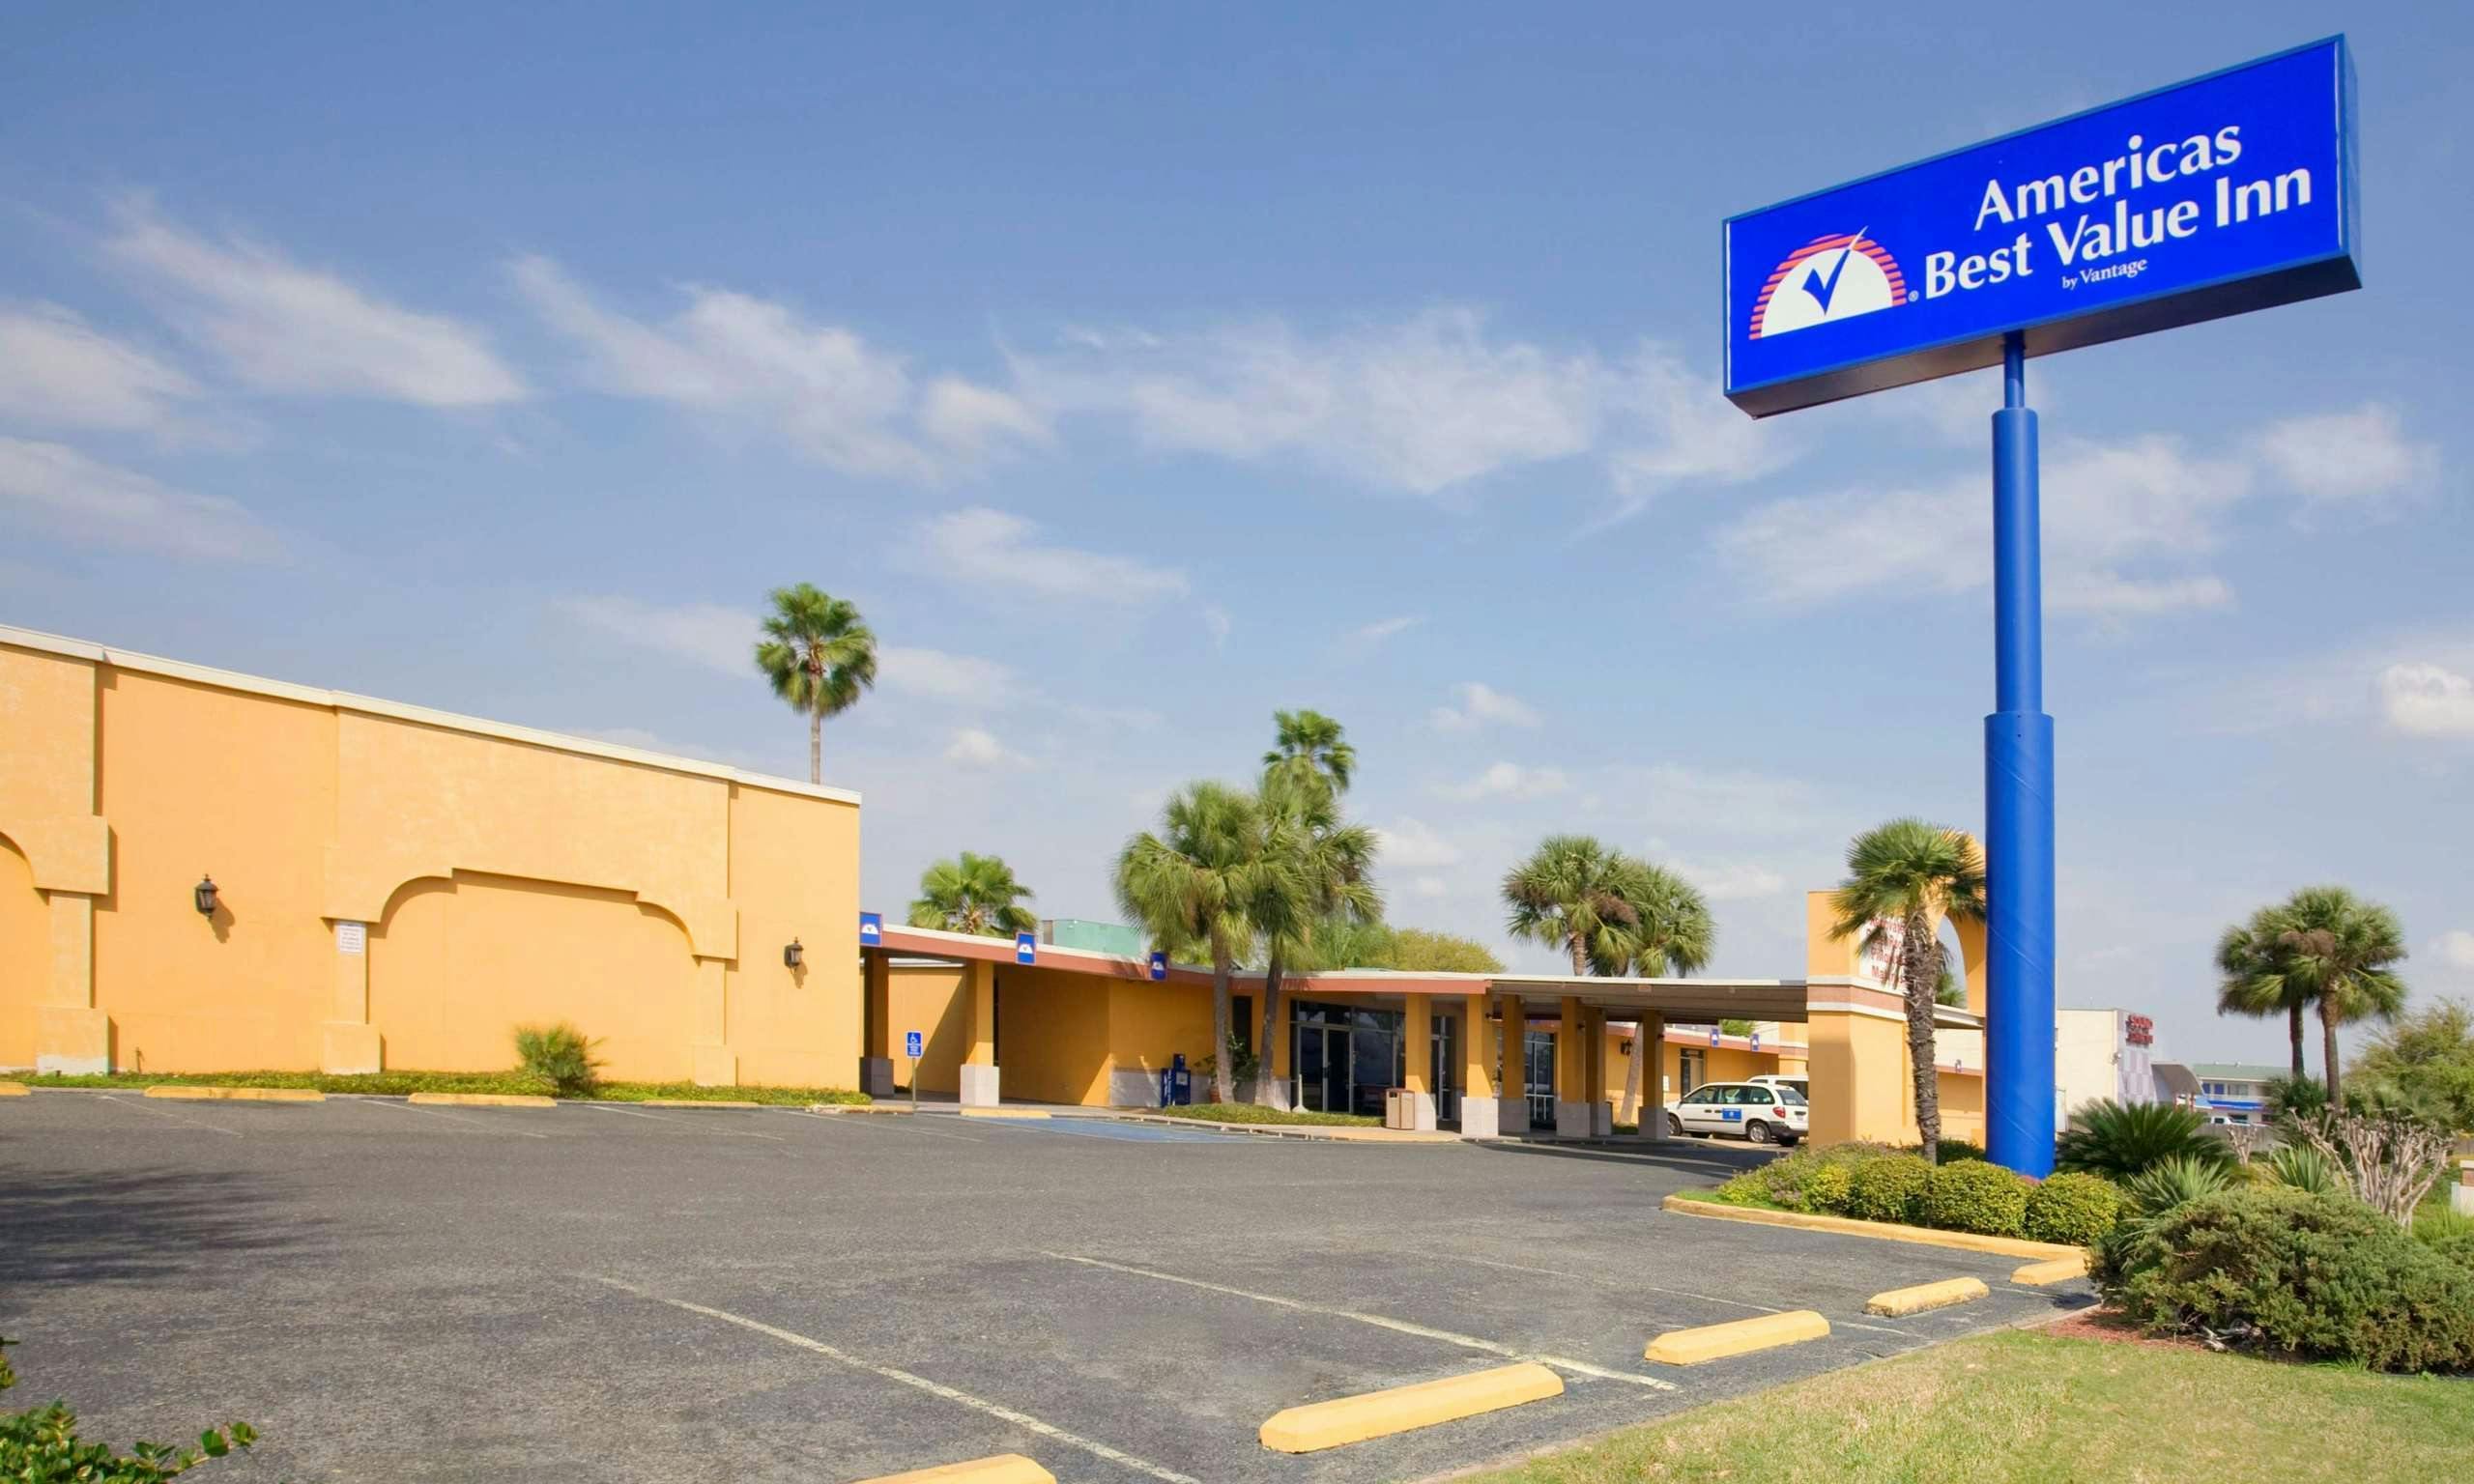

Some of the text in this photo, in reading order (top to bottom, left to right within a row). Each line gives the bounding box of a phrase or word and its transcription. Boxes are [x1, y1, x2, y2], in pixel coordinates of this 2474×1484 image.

[1974, 126, 2242, 231] Americas
[1925, 168, 2312, 300] Best Value Inn
[2061, 258, 2147, 290] by Vantage
